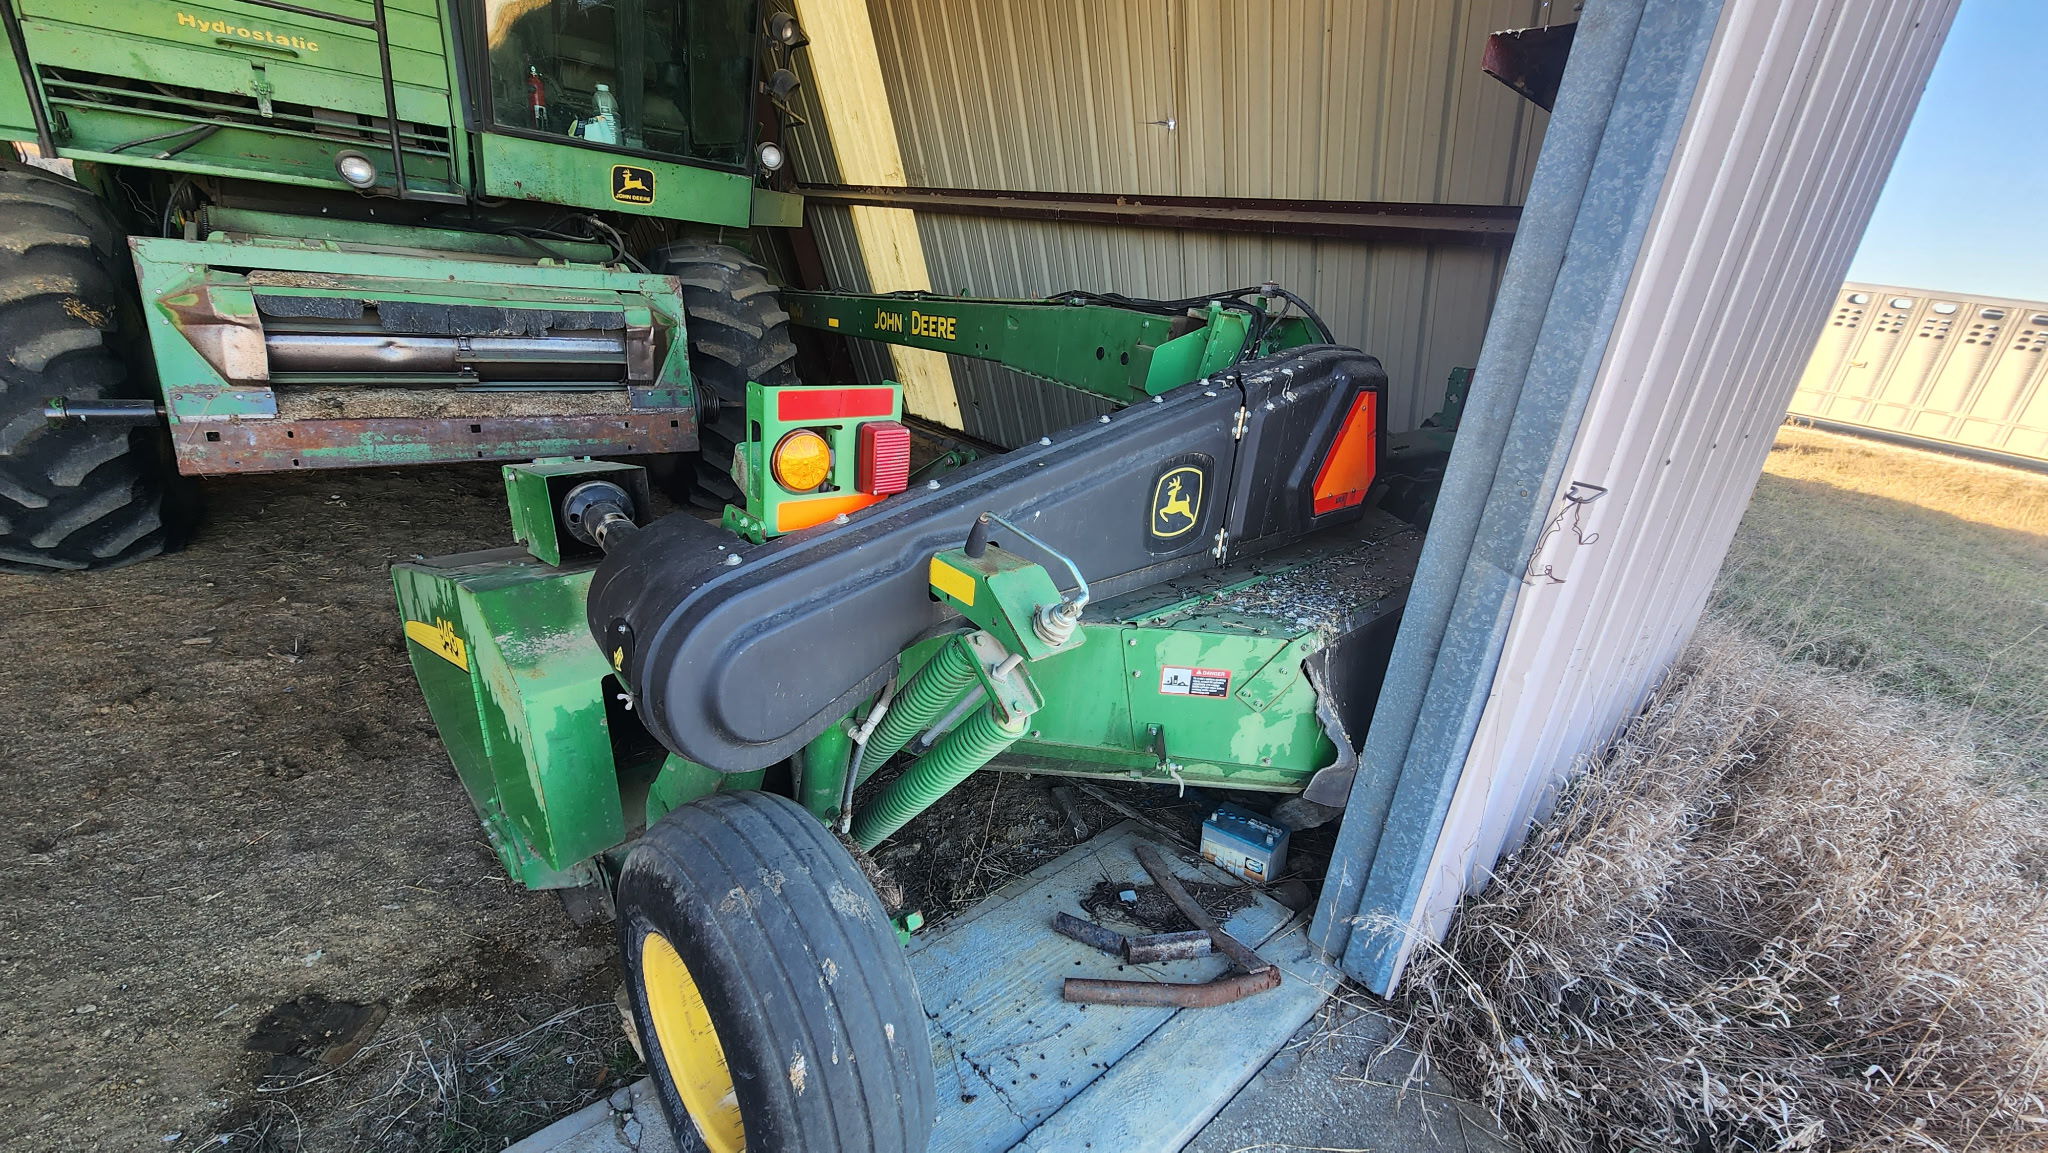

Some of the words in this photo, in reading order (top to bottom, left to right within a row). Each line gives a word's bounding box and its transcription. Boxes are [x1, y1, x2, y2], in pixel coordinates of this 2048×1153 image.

[176, 12, 320, 52] Hydrostatic
[874, 307, 903, 333] JOHN
[911, 310, 957, 340] DEERE
